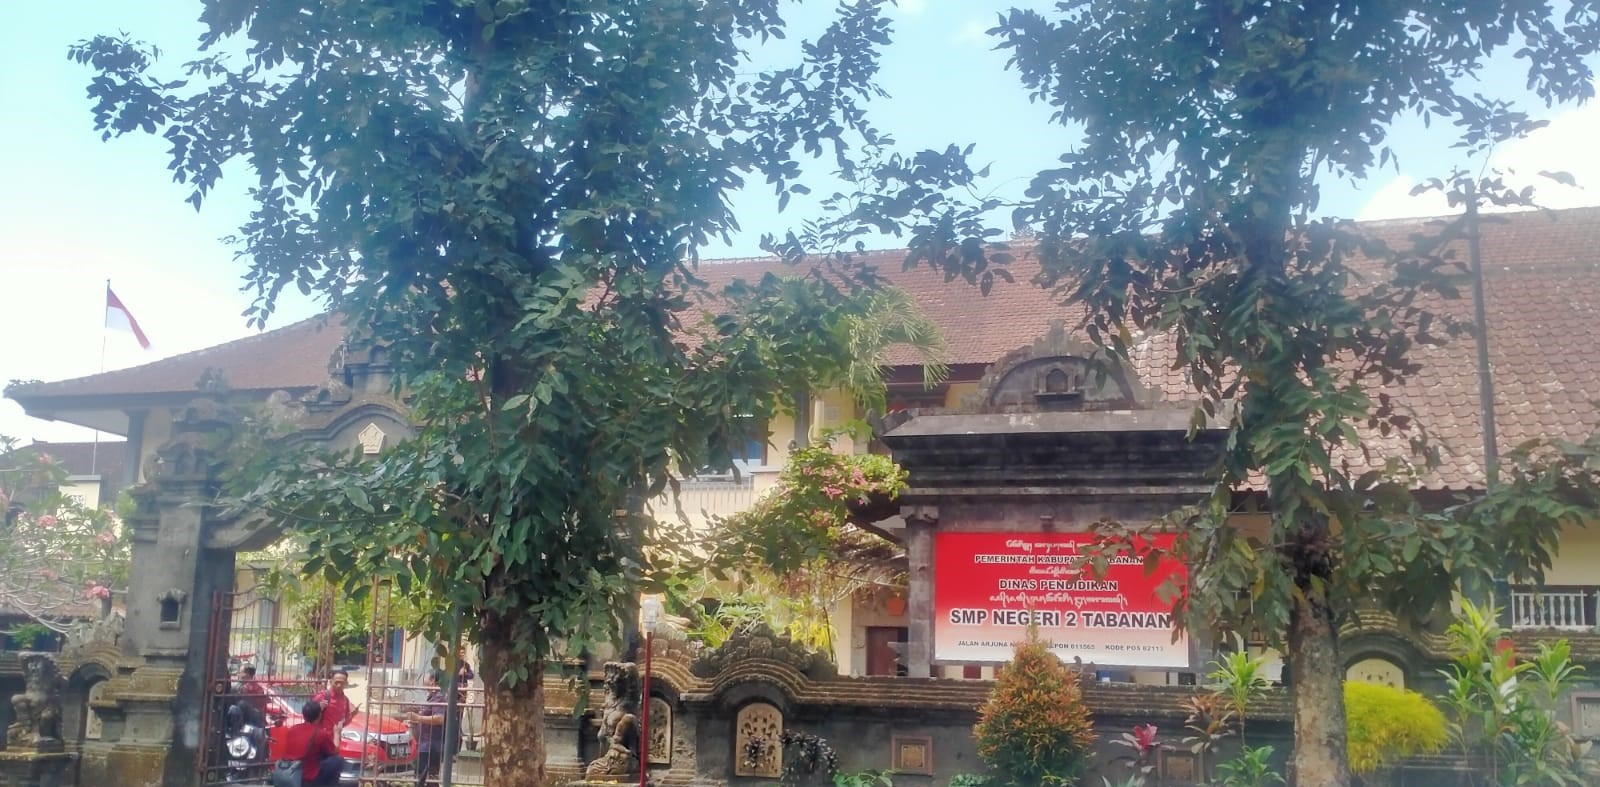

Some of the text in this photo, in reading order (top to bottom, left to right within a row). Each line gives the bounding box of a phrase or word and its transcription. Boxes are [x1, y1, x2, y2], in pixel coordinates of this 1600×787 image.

[975, 555, 1036, 564] PEMERINTAH
[999, 580, 1118, 592] DINAS PENDIDIKAN
[950, 609, 1171, 629] SMP NEGERI 2 TABANAN
